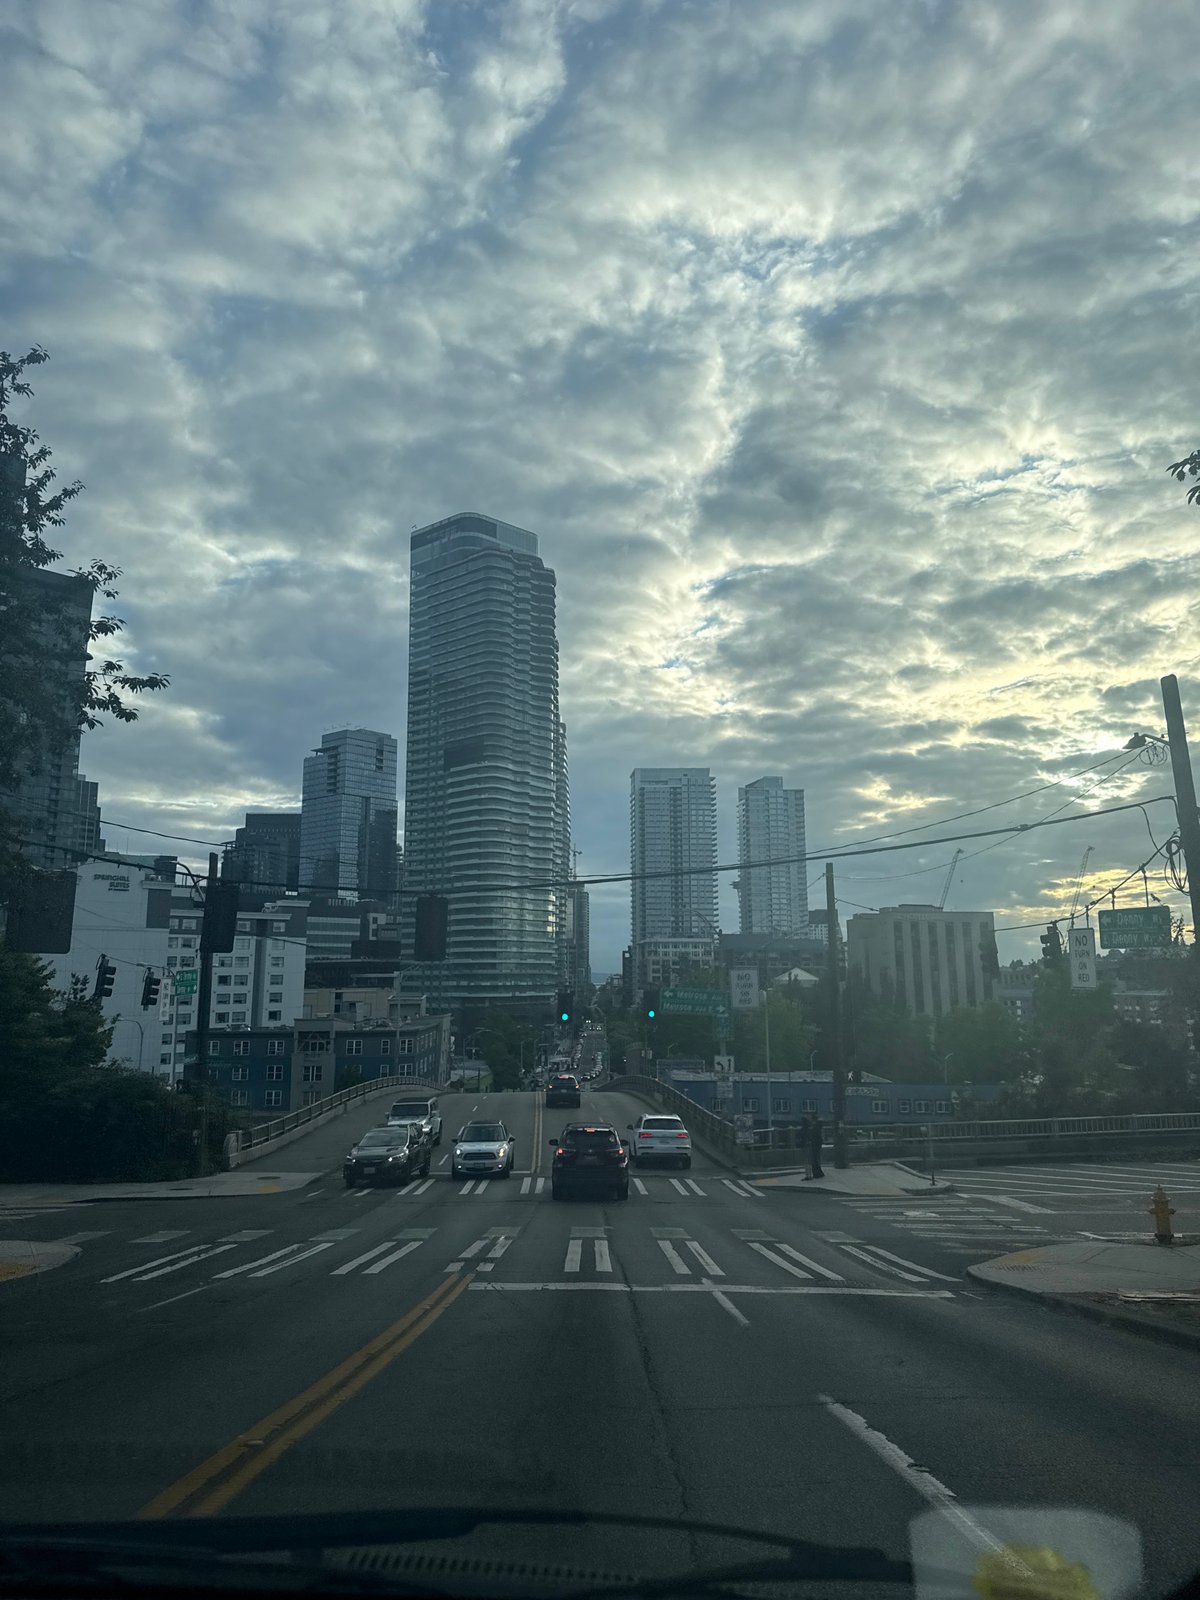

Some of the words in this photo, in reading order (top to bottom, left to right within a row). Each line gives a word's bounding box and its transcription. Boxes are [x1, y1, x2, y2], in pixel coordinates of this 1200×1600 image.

[1117, 912, 1144, 927] Denny
[1075, 935, 1088, 946] NO
[1112, 932, 1138, 945] Denny
[1074, 949, 1090, 958] TURN
[1079, 962, 1087, 970] ON
[737, 973, 751, 981] NO
[1078, 974, 1089, 983] RED
[677, 991, 708, 1000] Melrose
[663, 1003, 692, 1011] Melrose
